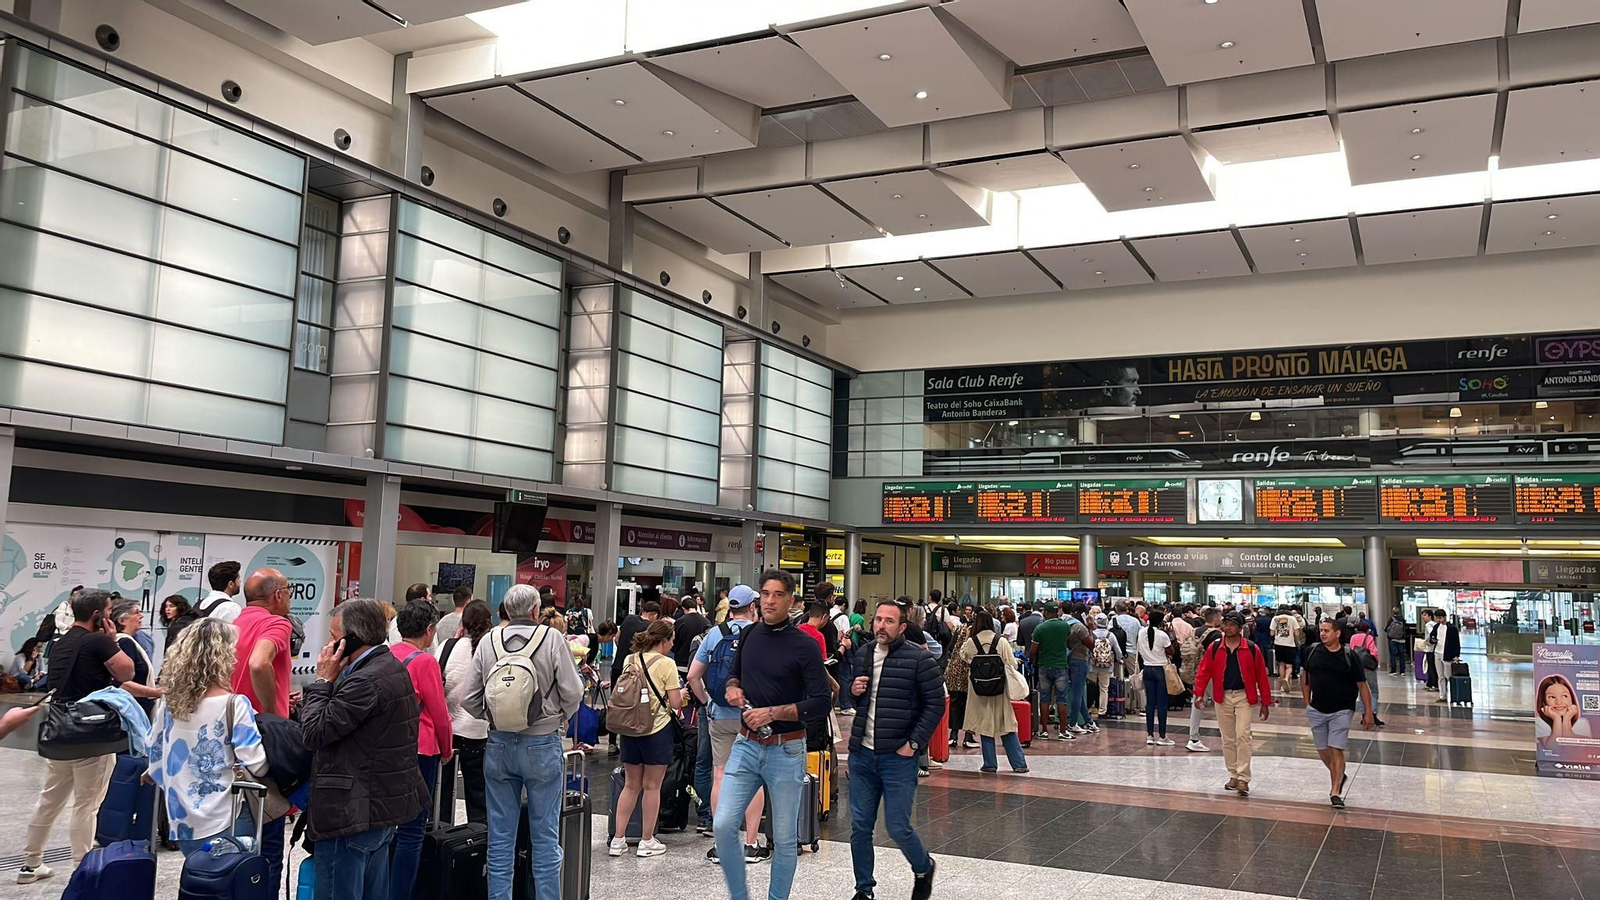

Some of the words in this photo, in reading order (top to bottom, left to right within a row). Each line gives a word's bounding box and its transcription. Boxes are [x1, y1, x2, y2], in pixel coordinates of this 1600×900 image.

[1458, 343, 1508, 363] renfe
[1168, 357, 1224, 382] HASTA
[1232, 352, 1310, 379] PRONTO
[1318, 345, 1408, 374] MÁLAGA
[927, 376, 954, 390] Sala
[957, 374, 984, 389] Club
[988, 372, 1024, 389] Renfe
[1459, 376, 1508, 391] SOHO
[1544, 375, 1577, 385] ANTONIO
[1195, 389, 1209, 399] LA
[1211, 384, 1258, 398] EMOCIÓN
[1261, 386, 1275, 397] DE
[1278, 384, 1324, 396] ENSAYAR
[1327, 383, 1342, 393] UN
[1345, 379, 1382, 393] SUEÑO
[926, 402, 949, 410] Teatro
[950, 400, 962, 409] del
[963, 399, 982, 409] Soho
[984, 398, 1024, 408] CaixaBank
[941, 409, 971, 418] Antonio
[972, 408, 1007, 417] Banderas
[1126, 454, 1144, 462] renfe
[1232, 446, 1290, 468] renfe
[728, 539, 742, 551] renf
[34, 552, 45, 561] SE
[180, 557, 202, 565] INTELI
[826, 552, 842, 560] ertz
[953, 556, 982, 564] Llegadas
[1044, 557, 1054, 565] No
[1055, 558, 1075, 566] pasar
[1126, 551, 1150, 567] 1-8
[1154, 551, 1182, 560] Acceso
[1190, 552, 1208, 560] vías
[1240, 552, 1272, 561] Control
[1274, 553, 1286, 561] de
[1288, 553, 1334, 565] equipajes
[33, 561, 57, 570] GURA
[180, 565, 202, 573] GENTE
[534, 556, 550, 571] iryo
[1555, 565, 1597, 575] Llegadas
